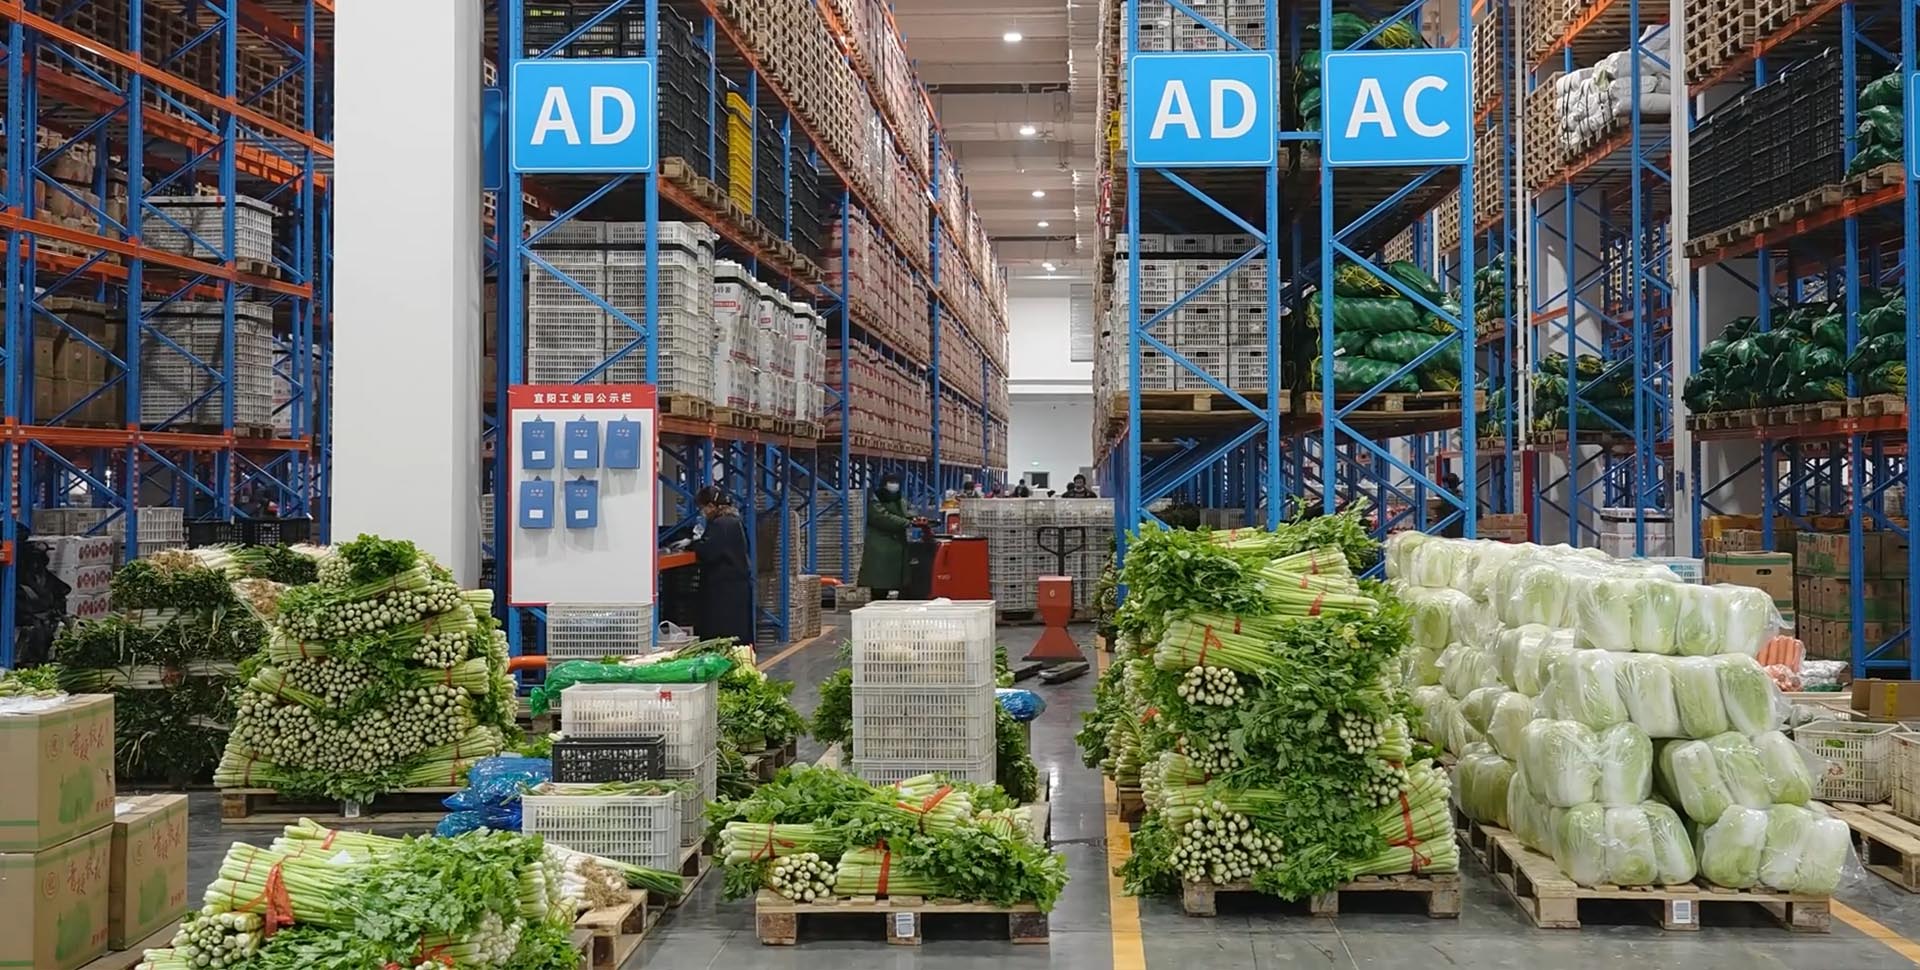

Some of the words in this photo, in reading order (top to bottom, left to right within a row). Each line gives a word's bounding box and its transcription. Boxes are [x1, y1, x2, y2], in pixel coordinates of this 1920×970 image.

[530, 86, 636, 145] AD
[1149, 79, 1257, 139] AD
[1345, 76, 1450, 138] AC
[533, 392, 633, 404] 宜阳工业园公示栏
